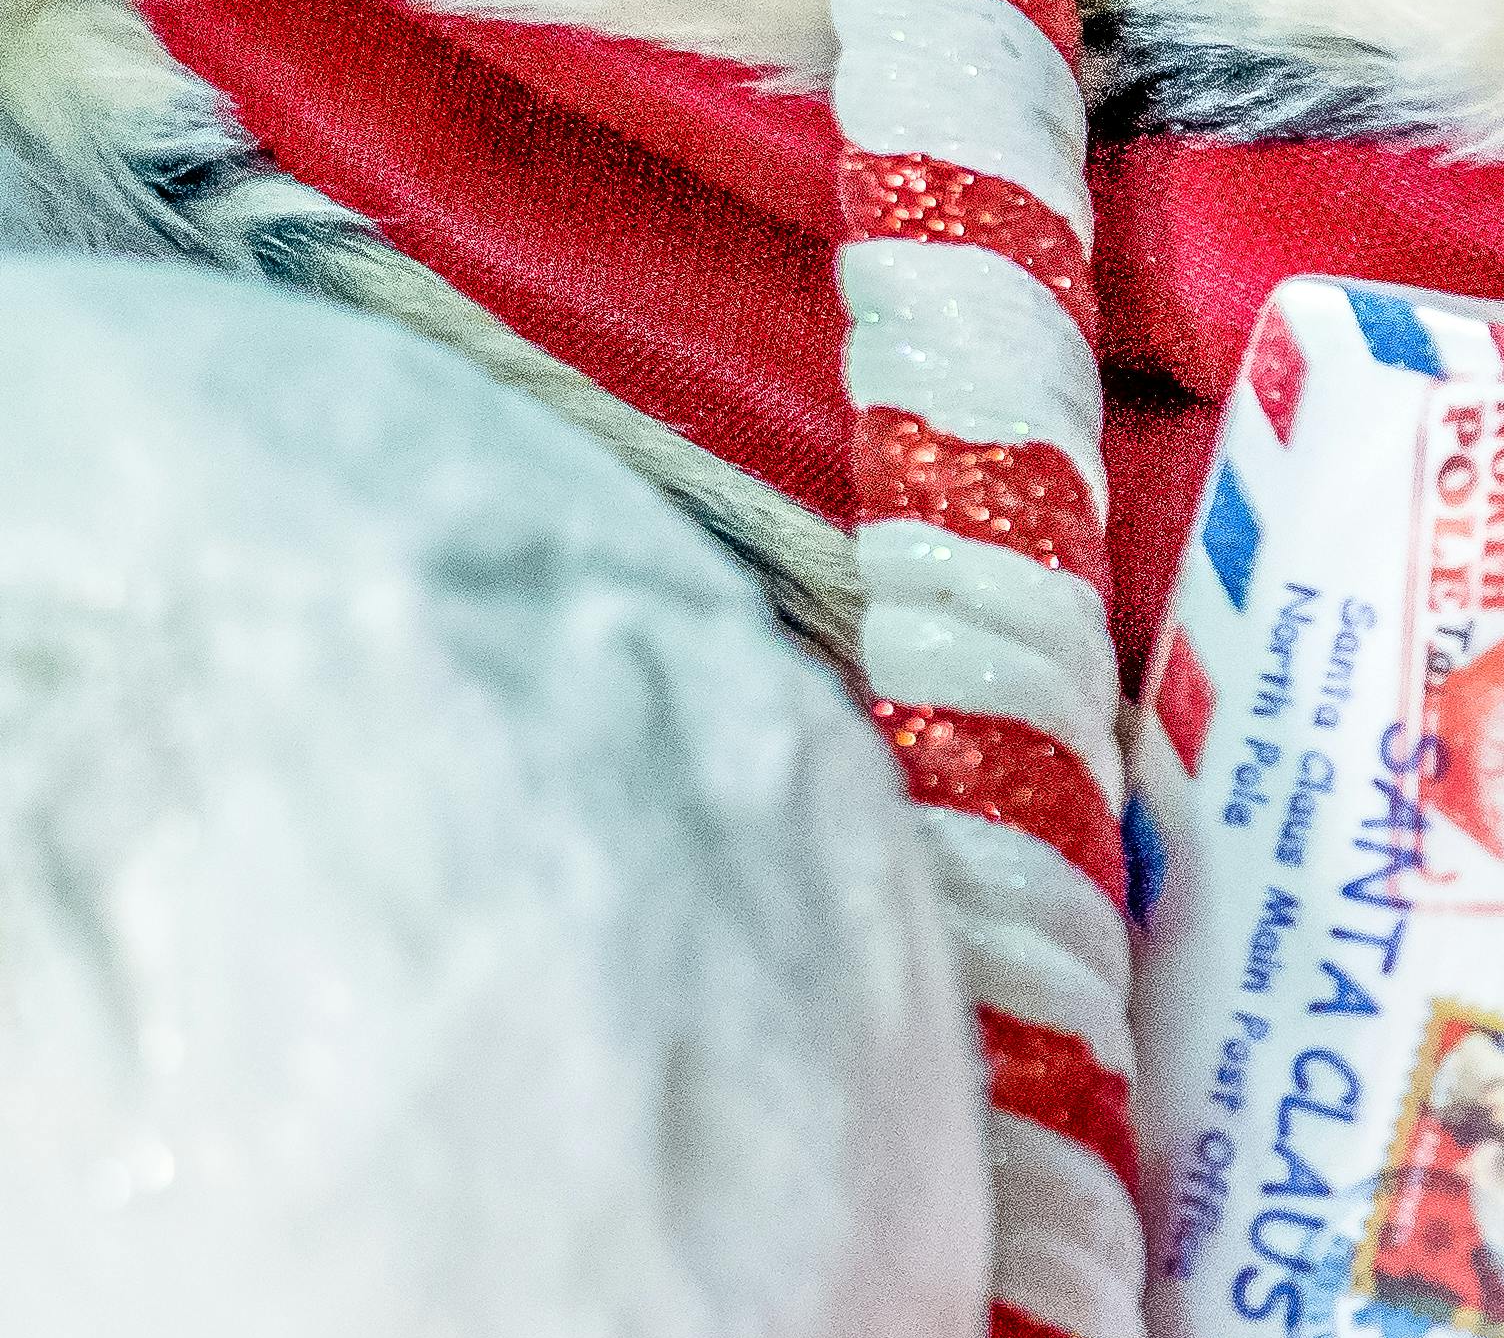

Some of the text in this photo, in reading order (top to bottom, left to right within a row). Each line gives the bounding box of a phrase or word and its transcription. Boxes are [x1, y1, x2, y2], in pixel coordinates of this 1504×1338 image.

[1429, 402, 1483, 614] POLE
[1223, 580, 1322, 829] North Pole
[1309, 593, 1376, 731] Santa
[1273, 747, 1337, 868] Claus
[1304, 718, 1448, 1017] SANTA
[1240, 884, 1301, 994] Main
[1208, 1007, 1272, 1115] Post
[1230, 1043, 1361, 1329] CLAUS
